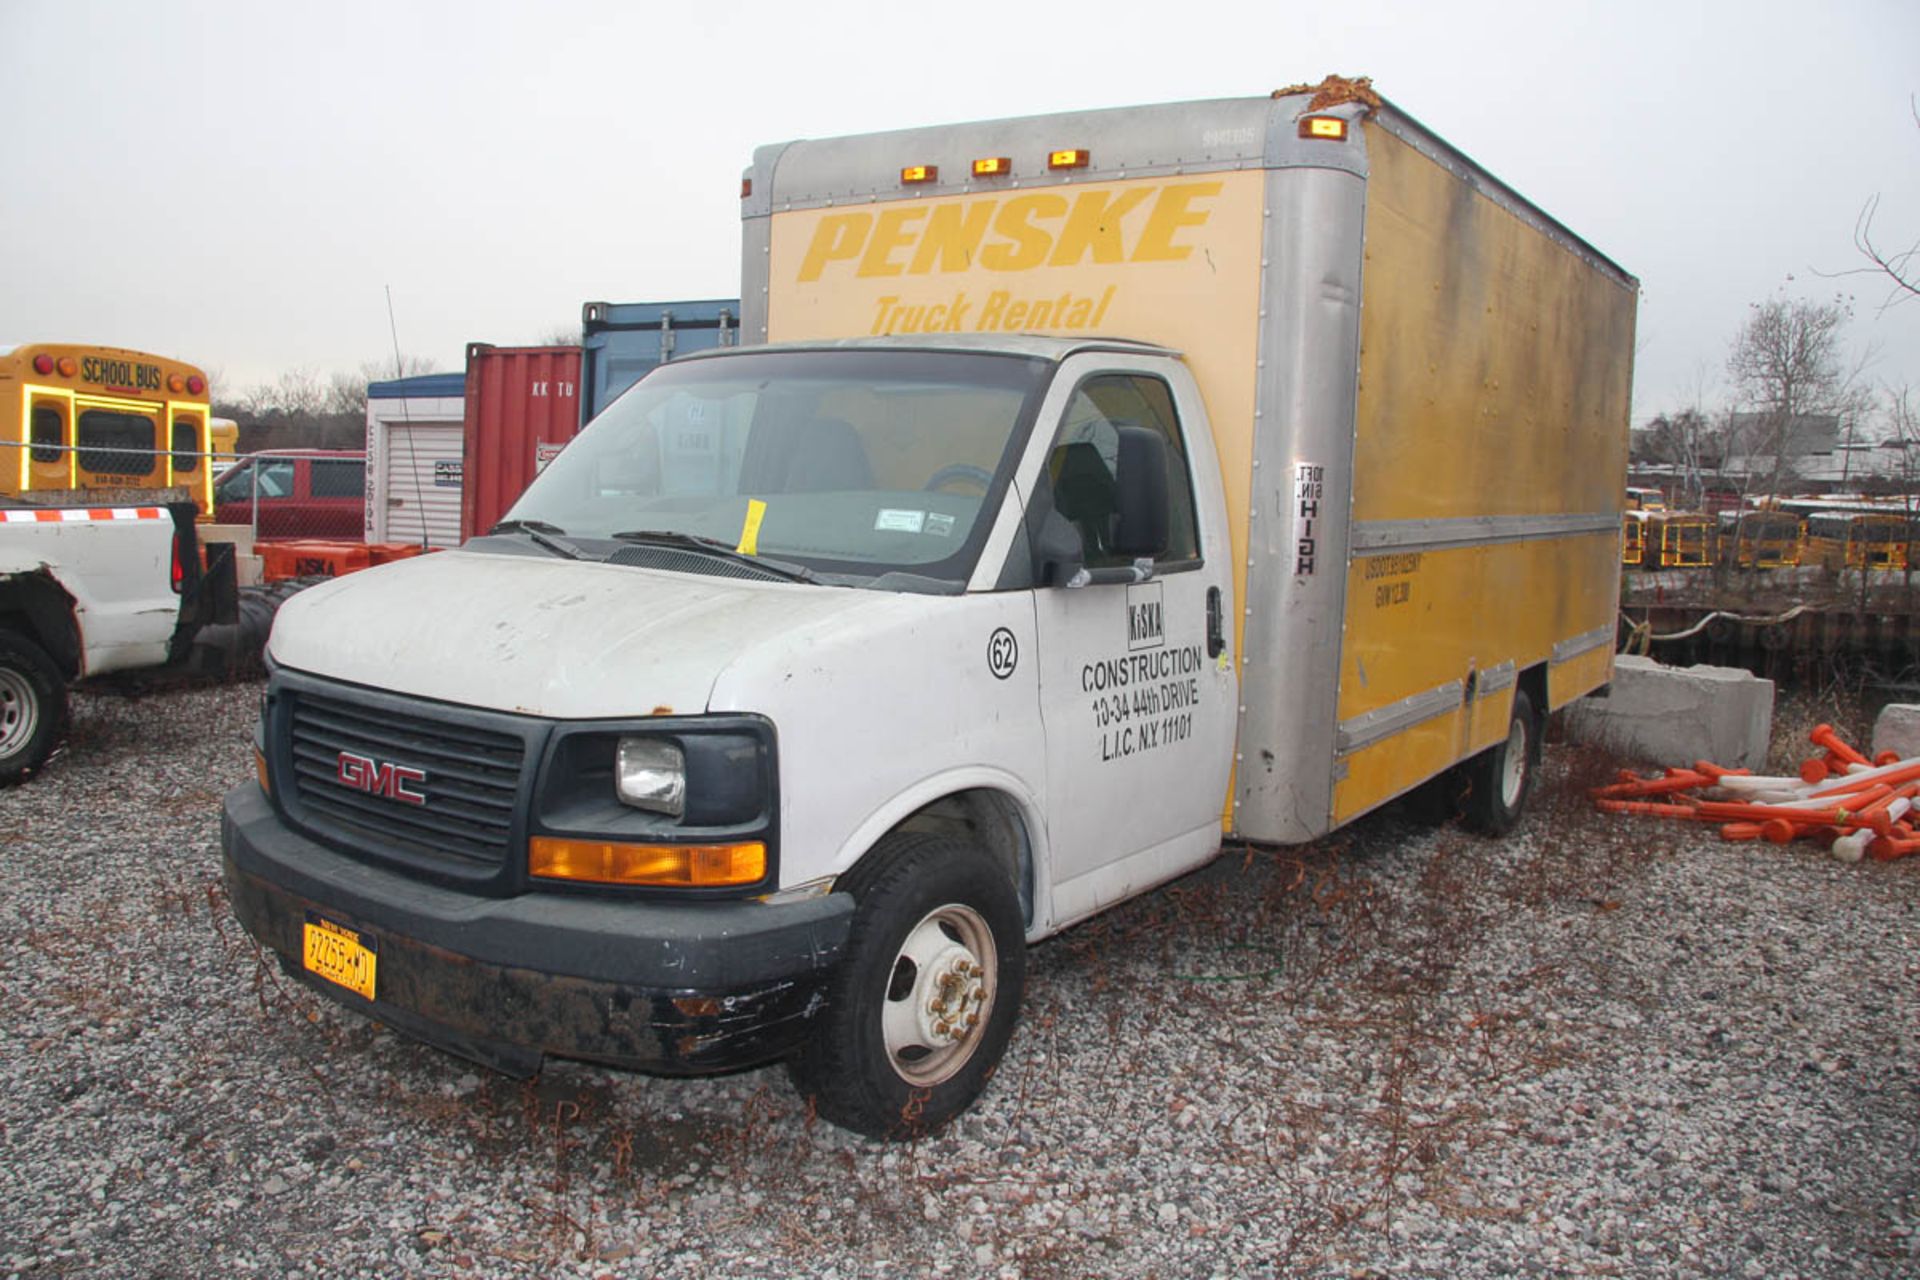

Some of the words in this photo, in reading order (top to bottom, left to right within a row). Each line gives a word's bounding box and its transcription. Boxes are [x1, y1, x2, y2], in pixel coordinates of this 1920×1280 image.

[797, 181, 1224, 283] PENSKE
[870, 292, 972, 336] Truck
[975, 284, 1118, 332] Rental
[82, 356, 133, 386] SCHOOL
[136, 362, 160, 390] BUS
[993, 636, 1013, 671] 62
[1082, 646, 1202, 693] CONSTRUCTION
[1092, 692, 1131, 729] 10-34
[1133, 688, 1161, 719] 44th
[1160, 678, 1199, 712] DRIVE
[1161, 712, 1193, 745] 11101
[338, 751, 425, 805] GMC
